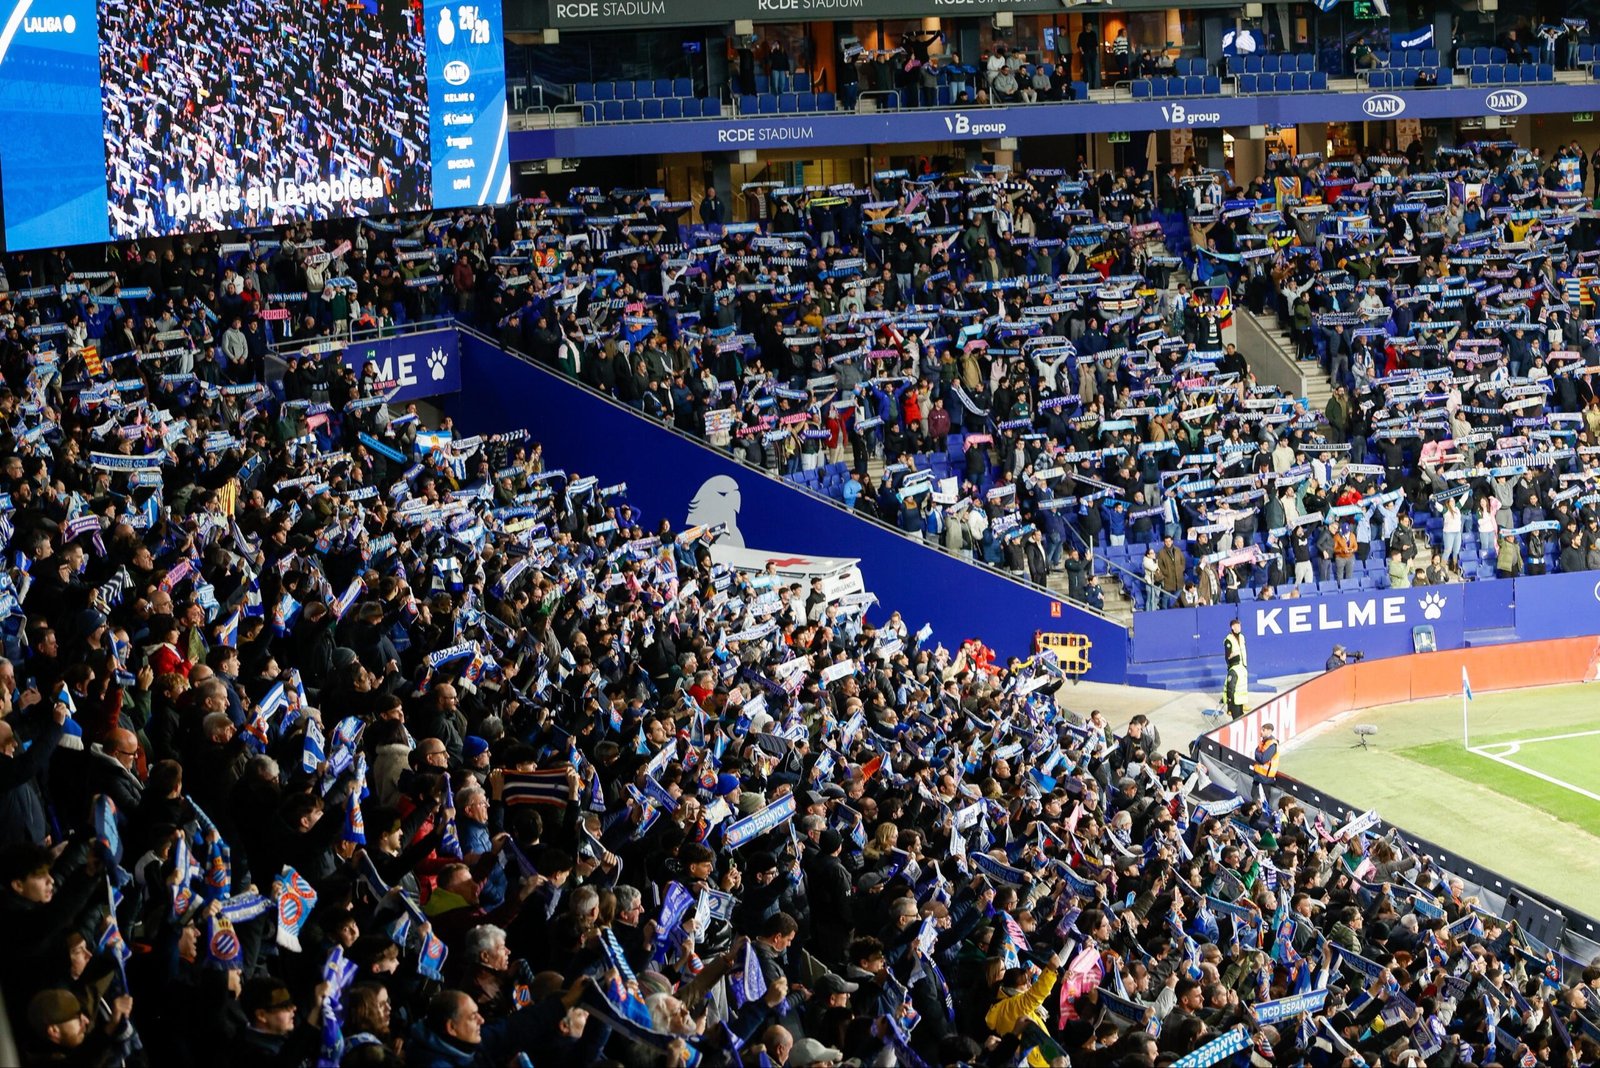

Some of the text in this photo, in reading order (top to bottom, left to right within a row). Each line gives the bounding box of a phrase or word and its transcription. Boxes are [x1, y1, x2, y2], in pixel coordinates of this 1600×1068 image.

[557, 1, 666, 19] RCDE STADIUM
[758, 0, 798, 11] RCDE
[24, 17, 62, 33] LALIGA
[1367, 100, 1397, 113] DANI
[1490, 95, 1518, 108] DANI
[1187, 111, 1220, 124] group
[718, 126, 813, 142] RCDE STADIUM
[972, 122, 1006, 135] group
[167, 184, 240, 219] forjats
[247, 187, 274, 209] en
[299, 175, 383, 204] noblesa
[1257, 596, 1407, 637] KELME
[1229, 689, 1297, 761] DAMM
[755, 804, 786, 829] ESPANYOL
[1262, 995, 1322, 1019] RCD ESPANYOL
[1197, 1030, 1245, 1065] ESPANYOL
